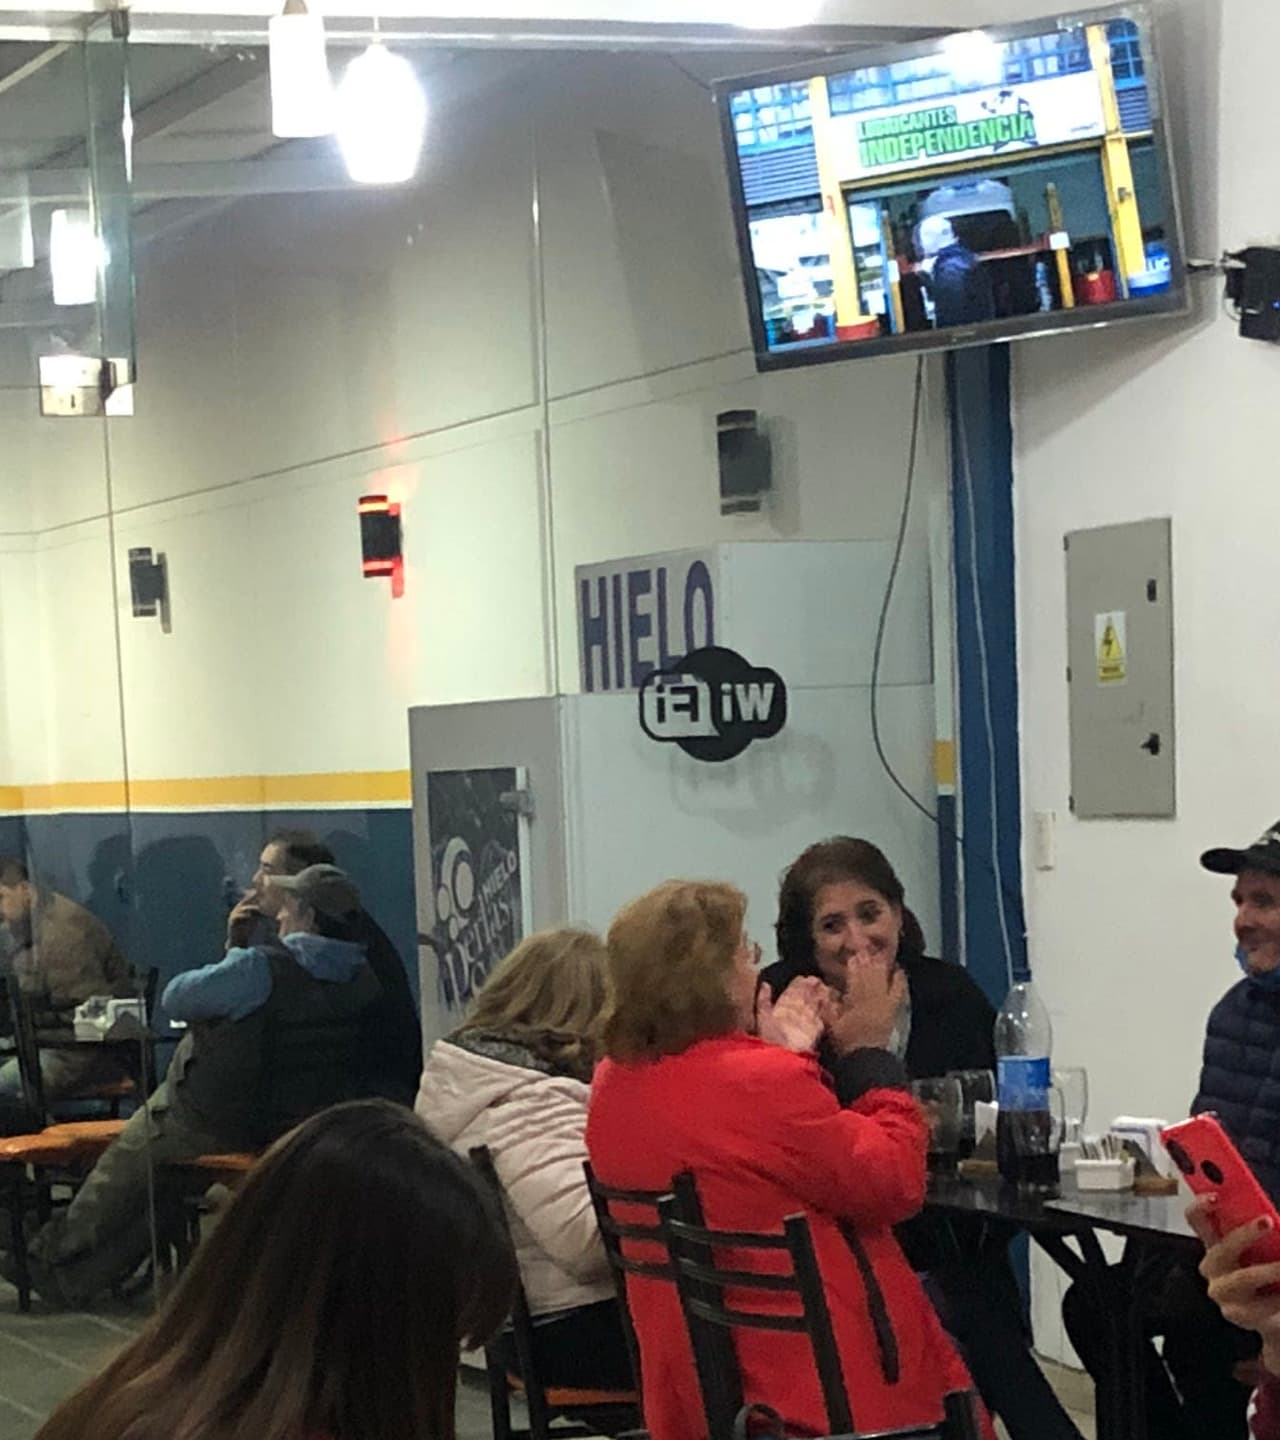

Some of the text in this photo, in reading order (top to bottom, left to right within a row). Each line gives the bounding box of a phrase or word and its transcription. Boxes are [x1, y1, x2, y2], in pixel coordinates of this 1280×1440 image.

[860, 115, 1035, 167] INDEPENDENCIA
[581, 560, 714, 692] HIELO
[482, 850, 517, 900] HIELO
